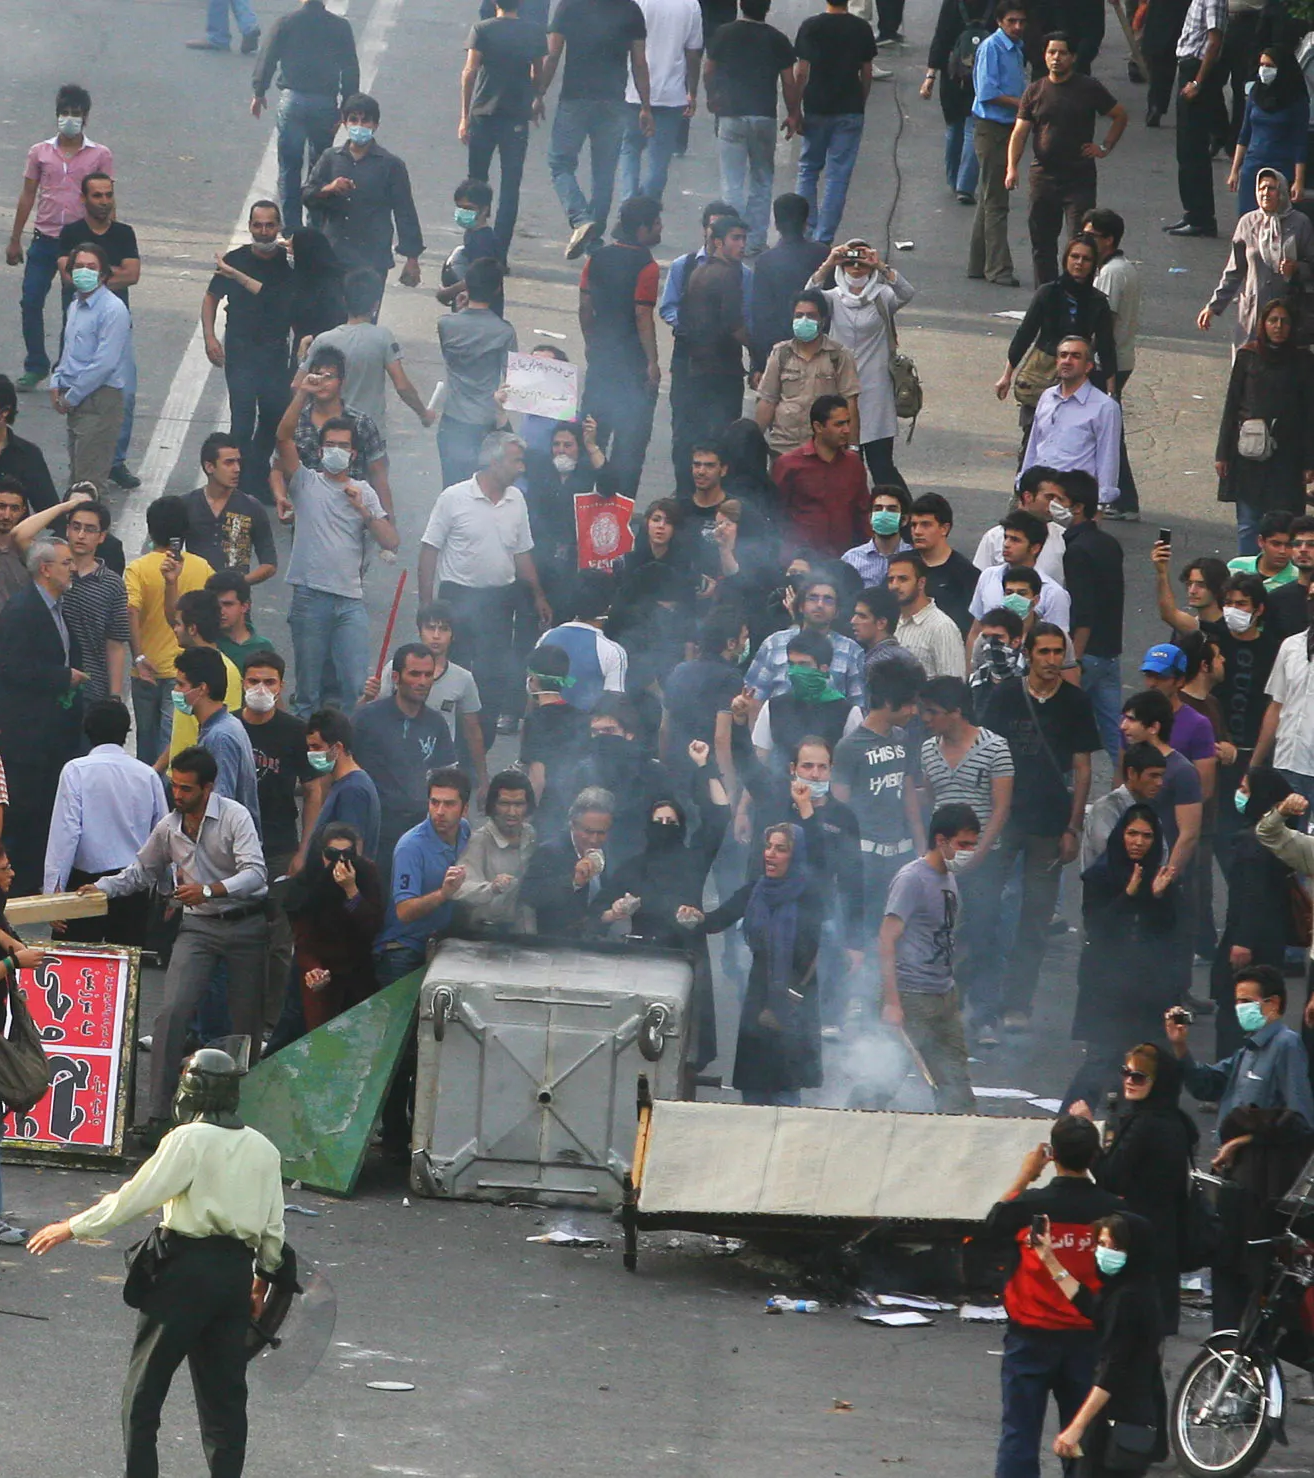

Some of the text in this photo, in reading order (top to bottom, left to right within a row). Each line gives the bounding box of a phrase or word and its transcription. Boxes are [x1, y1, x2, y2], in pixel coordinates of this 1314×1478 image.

[865, 744, 906, 766] THIS IS
[399, 874, 411, 890] 3
[35, 956, 74, 1042] وحی
[74, 968, 101, 1036] به سرزمین
[46, 1054, 92, 1141] حج
